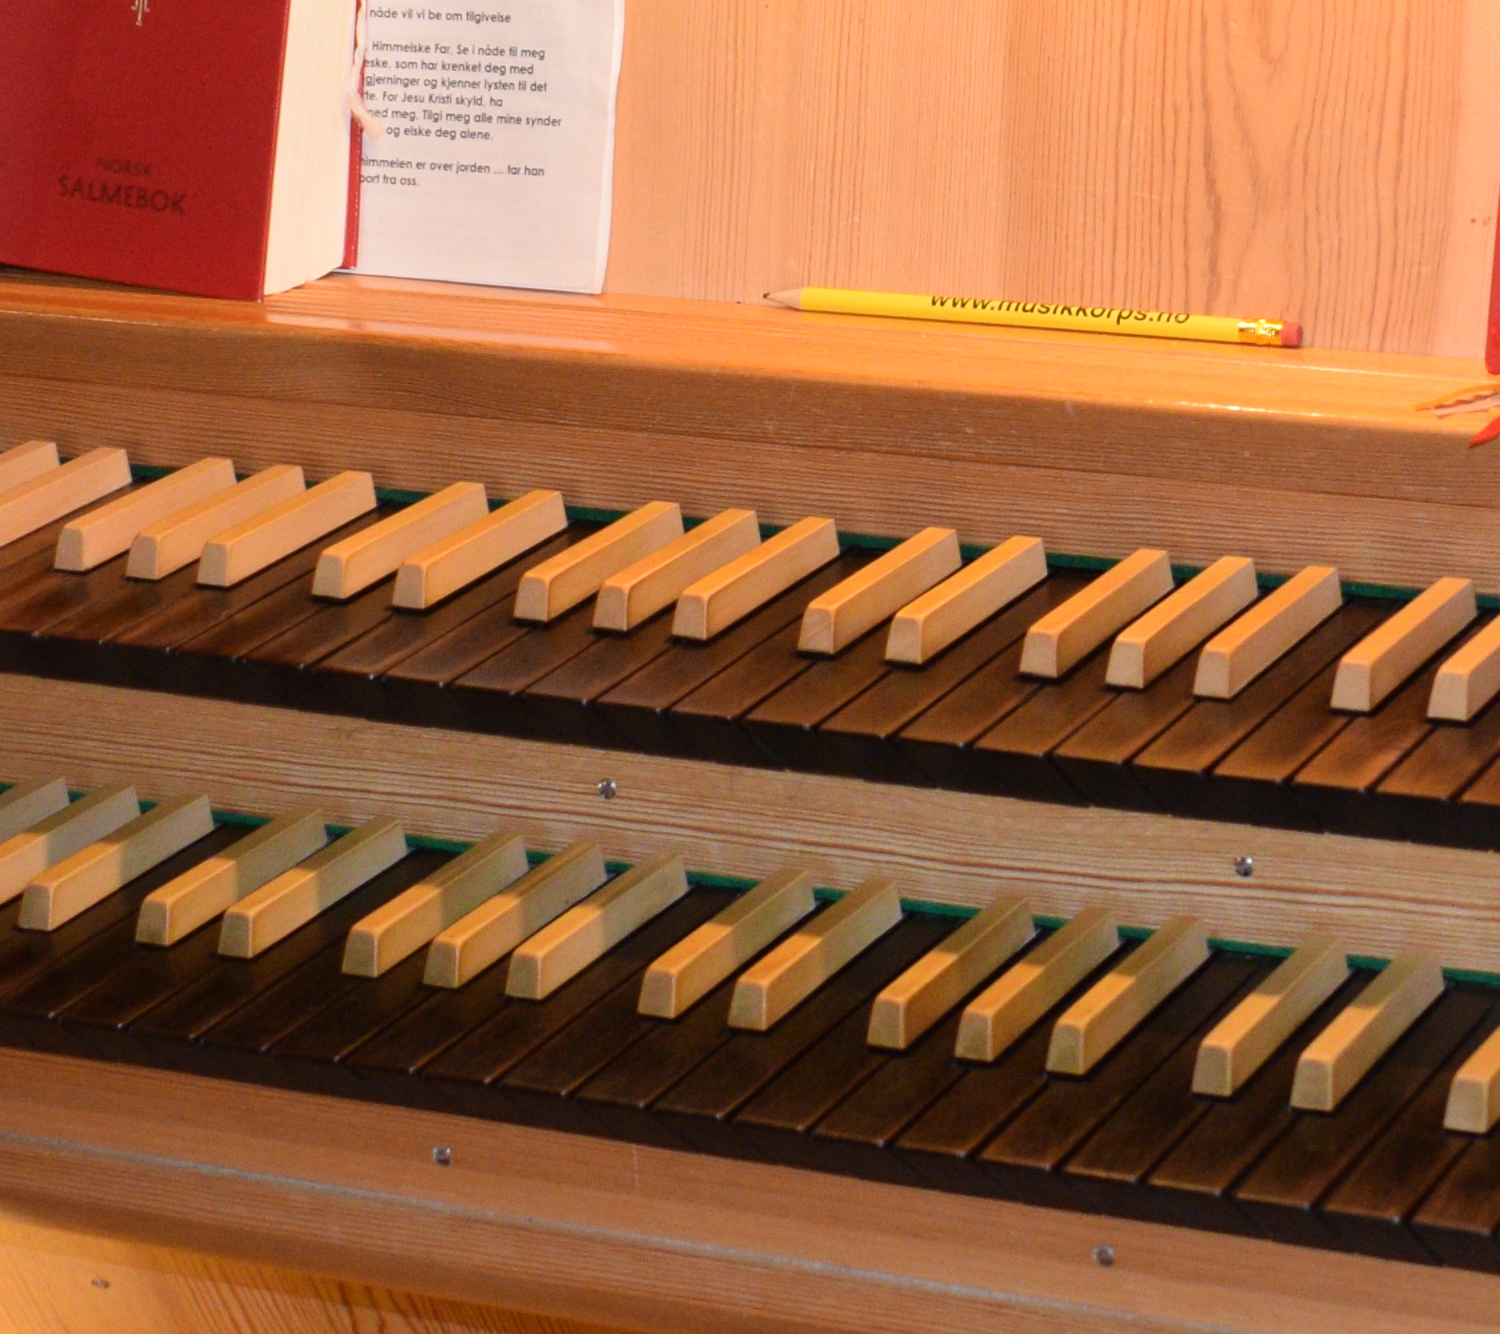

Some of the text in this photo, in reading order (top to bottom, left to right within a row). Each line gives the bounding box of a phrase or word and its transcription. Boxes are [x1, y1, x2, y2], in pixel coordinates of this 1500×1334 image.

[369, 7, 398, 18] nåde
[401, 9, 413, 19] vil
[429, 9, 442, 21] be
[446, 11, 463, 21] om
[372, 41, 430, 54] Himmelske
[456, 44, 469, 55] Se
[478, 44, 506, 57] nåde
[521, 49, 546, 62] meg
[395, 60, 417, 70] som
[421, 60, 437, 71] har
[442, 61, 481, 73] krenket
[485, 63, 506, 76] deg
[510, 65, 534, 76] med
[424, 79, 437, 90] og
[442, 76, 481, 91] kjenner
[484, 79, 515, 92] lysten
[531, 81, 548, 92] det
[383, 91, 398, 102] For
[402, 92, 425, 103] Jesu
[429, 93, 452, 105] Kristi
[489, 96, 504, 107] ha
[446, 112, 471, 124] meg
[474, 112, 493, 123] alle
[497, 114, 523, 125] mine
[525, 115, 562, 128] synder
[386, 126, 400, 138] og
[404, 126, 432, 139] elske
[435, 128, 456, 141] deg
[416, 160, 426, 171] er
[429, 161, 452, 173] over
[455, 160, 490, 174] jorden
[524, 166, 545, 176] han
[59, 175, 188, 216] SALMEBOK
